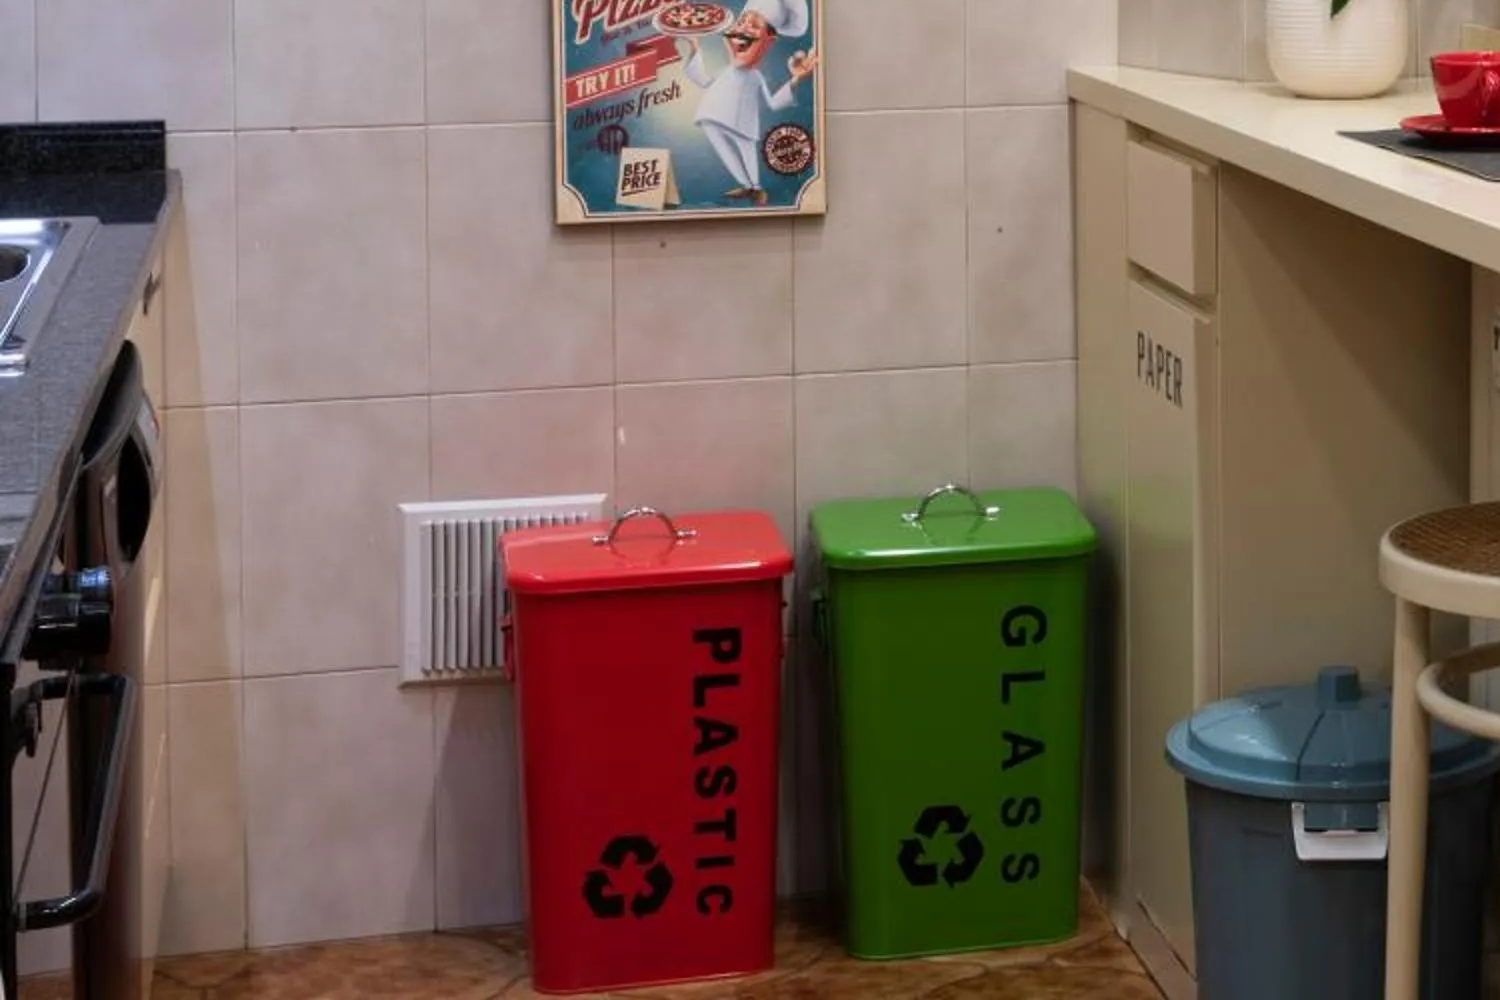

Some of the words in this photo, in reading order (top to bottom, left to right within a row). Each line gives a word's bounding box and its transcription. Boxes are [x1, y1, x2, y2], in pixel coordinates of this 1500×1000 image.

[574, 99, 635, 131] always
[637, 79, 681, 117] fresh
[575, 71, 609, 98] TRY
[615, 63, 636, 86] IT!
[621, 172, 662, 191] PRICE
[624, 158, 658, 177] BEST
[1137, 331, 1183, 410] PAPER
[1001, 604, 1047, 884] GLASS
[692, 627, 742, 916] PLASTIC
